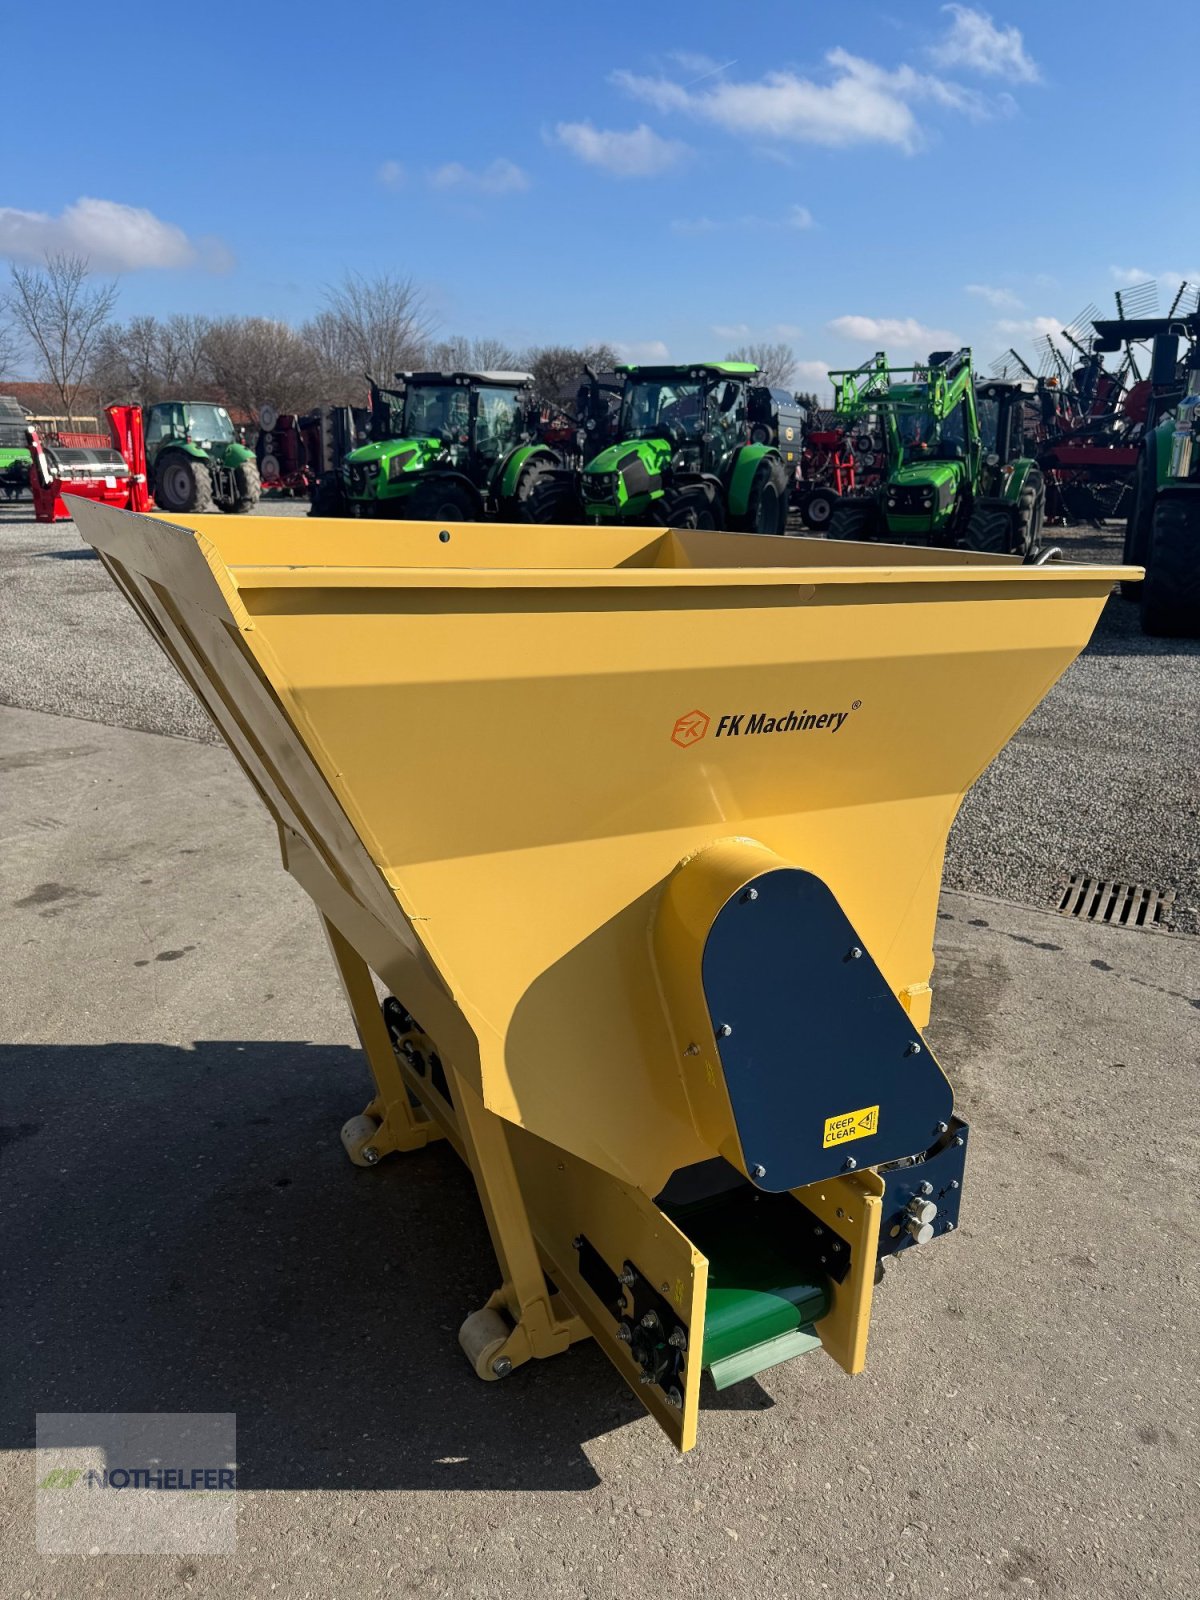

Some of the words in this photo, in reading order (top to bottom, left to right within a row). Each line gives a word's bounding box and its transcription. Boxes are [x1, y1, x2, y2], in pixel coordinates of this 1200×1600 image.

[715, 714, 745, 738] FK
[744, 709, 849, 735] Machinery
[829, 1117, 855, 1132] KEEP
[825, 1126, 856, 1142] CLEAR
